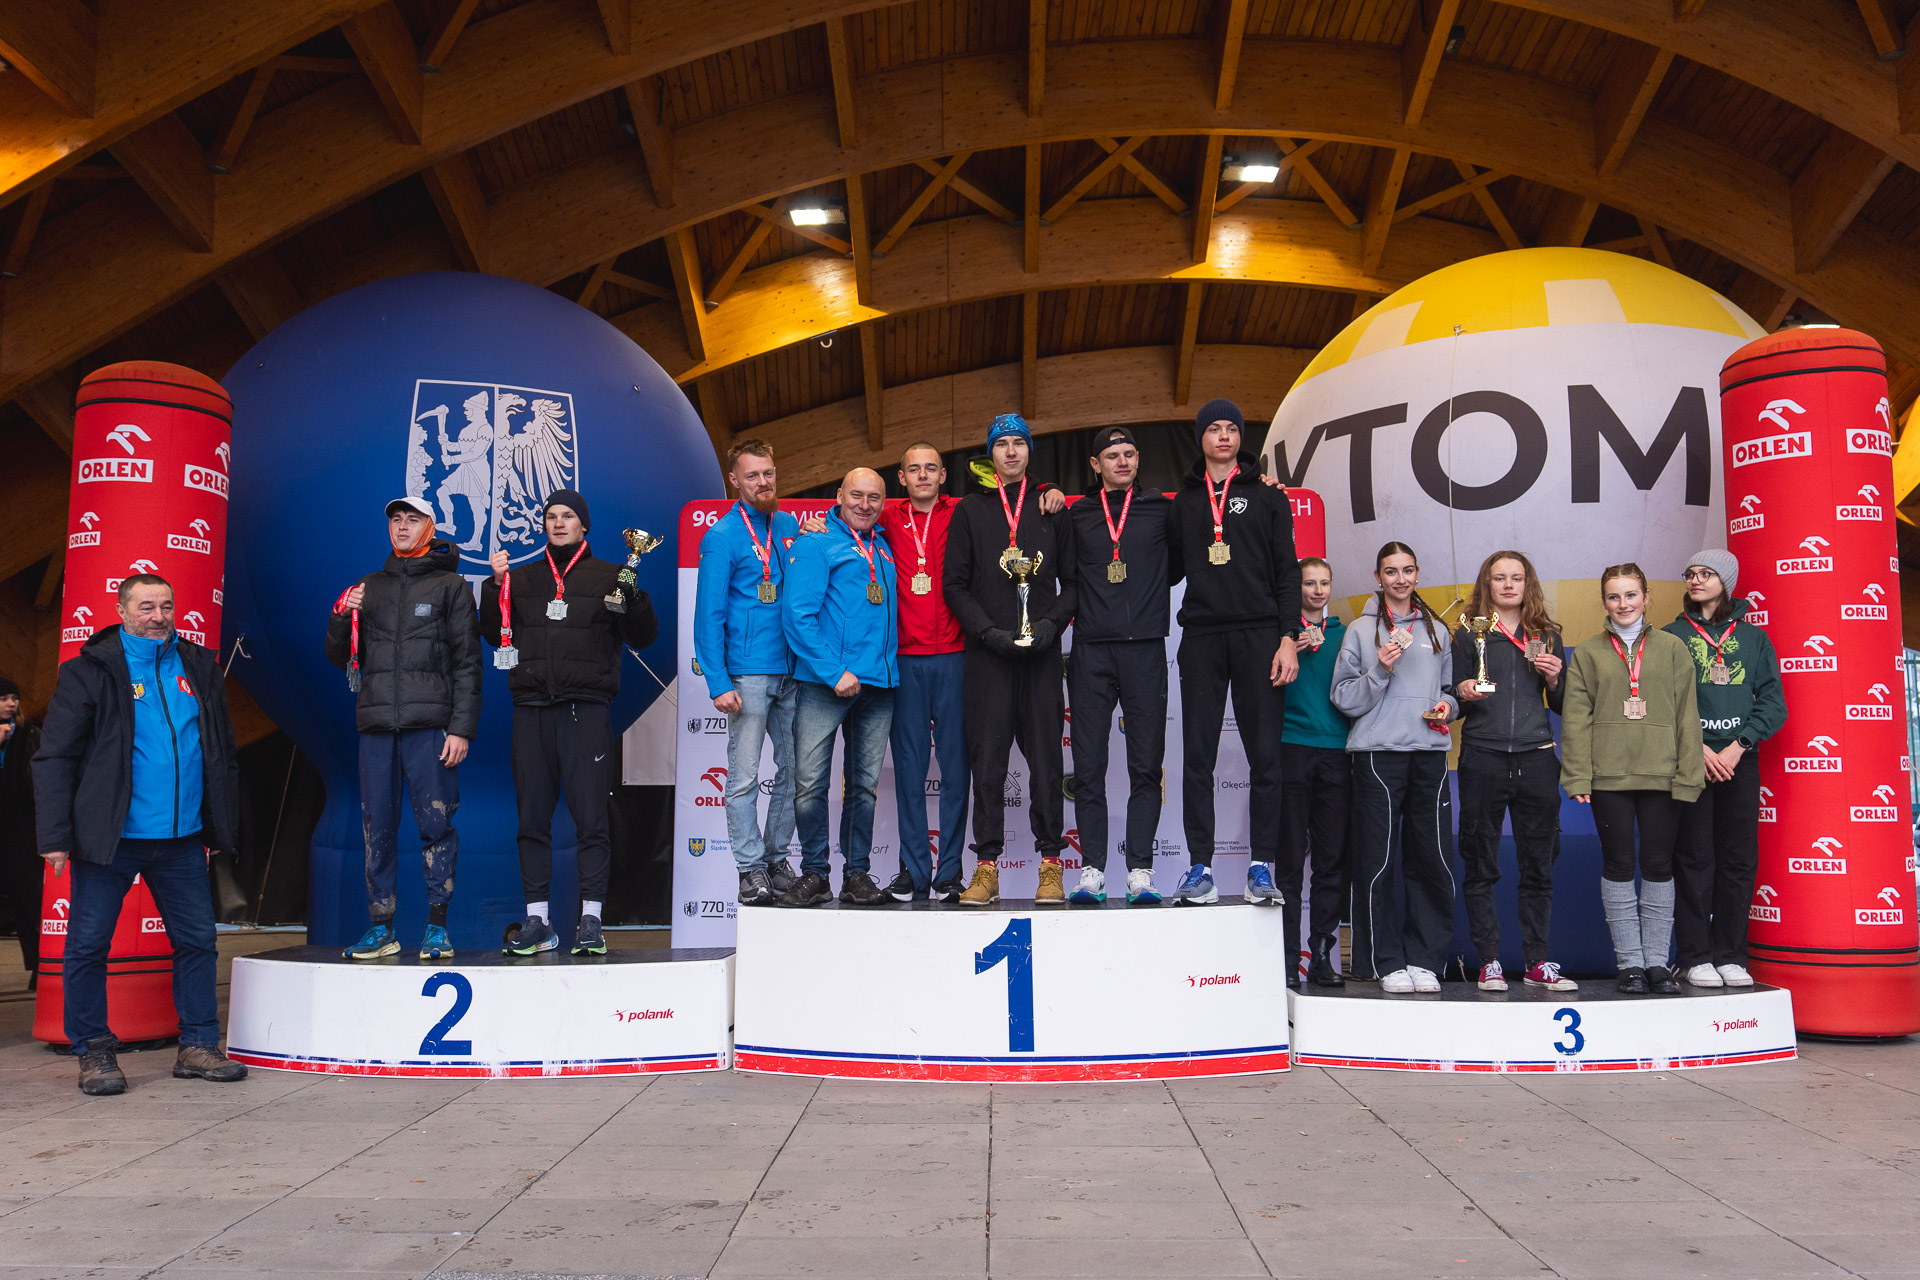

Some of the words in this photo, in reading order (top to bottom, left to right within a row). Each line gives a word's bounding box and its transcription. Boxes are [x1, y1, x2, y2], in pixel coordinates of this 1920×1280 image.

[1735, 435, 1805, 463] ORLEN
[81, 462, 147, 479] ORLEN
[1839, 507, 1881, 519] ORLEN
[1731, 516, 1761, 532] ORLEN
[70, 533, 97, 547] ORLEN
[170, 537, 209, 552] ORLEN
[1779, 559, 1829, 572] ORLEN
[1844, 607, 1885, 618] ORLEN
[63, 629, 91, 640] ORLEN
[1783, 659, 1834, 671] ORLEN
[1849, 707, 1890, 718] ORLEN
[704, 717, 727, 730] 770
[1787, 759, 1838, 770] ORLEN
[926, 780, 940, 791] 70
[1221, 781, 1250, 790] Okęcie
[695, 796, 726, 807] ORL
[1853, 808, 1896, 820] ORLEN
[872, 844, 889, 855] ort
[1791, 860, 1843, 872] ORLEN
[701, 901, 724, 913] 770
[1859, 911, 1901, 923] ORLEN
[974, 918, 1035, 1052] 1
[1199, 973, 1241, 988] polanik
[418, 971, 473, 1056] 2
[628, 1007, 674, 1022] polanik
[1723, 1018, 1759, 1032] polanik
[1553, 1007, 1585, 1056] 3
